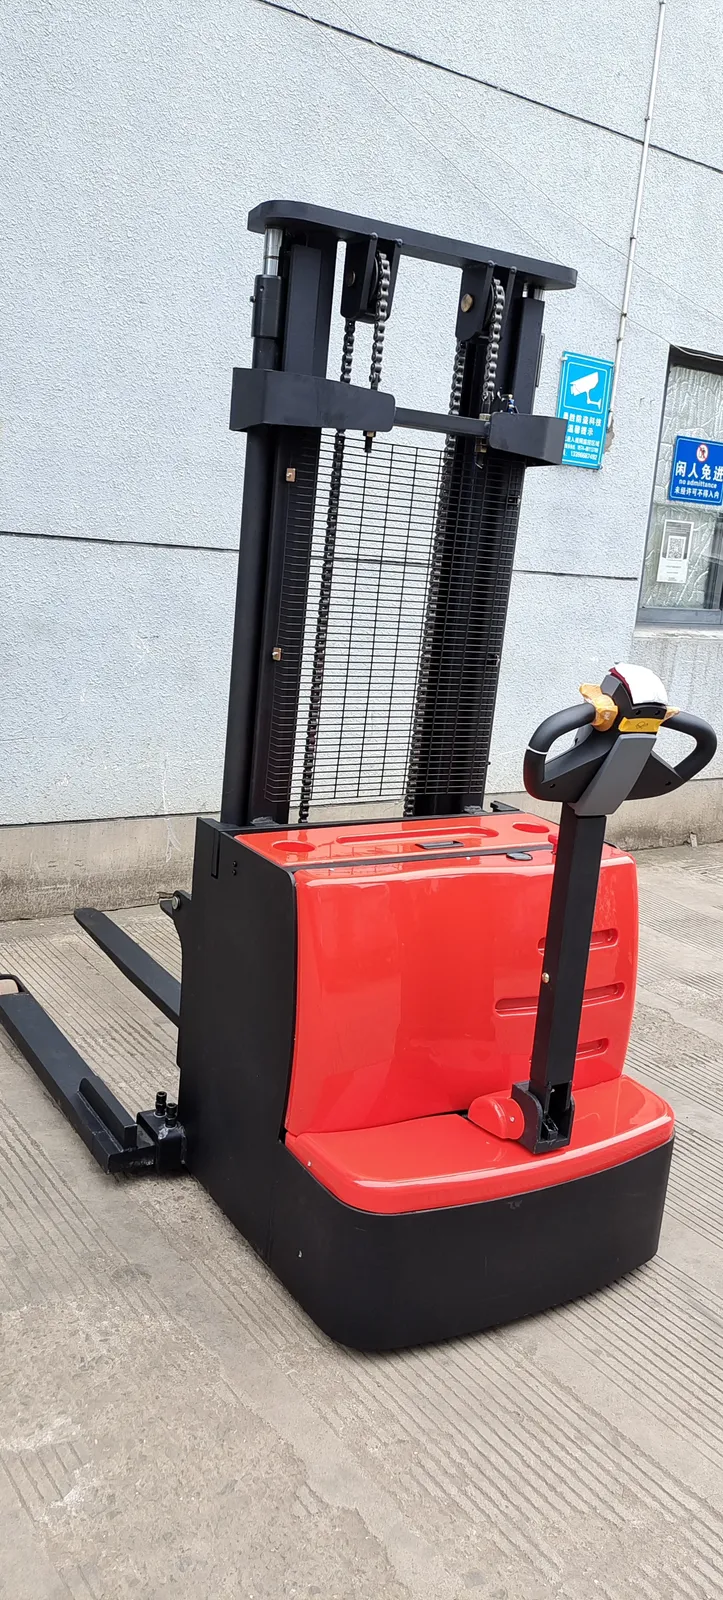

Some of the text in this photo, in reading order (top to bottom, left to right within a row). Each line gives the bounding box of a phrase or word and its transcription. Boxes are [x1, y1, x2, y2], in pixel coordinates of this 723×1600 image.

[567, 424, 594, 437] 温馨提示
[675, 460, 723, 482] 闲人免进
[687, 479, 717, 489] admittance
[674, 486, 720, 499] 未经许可不得入内
